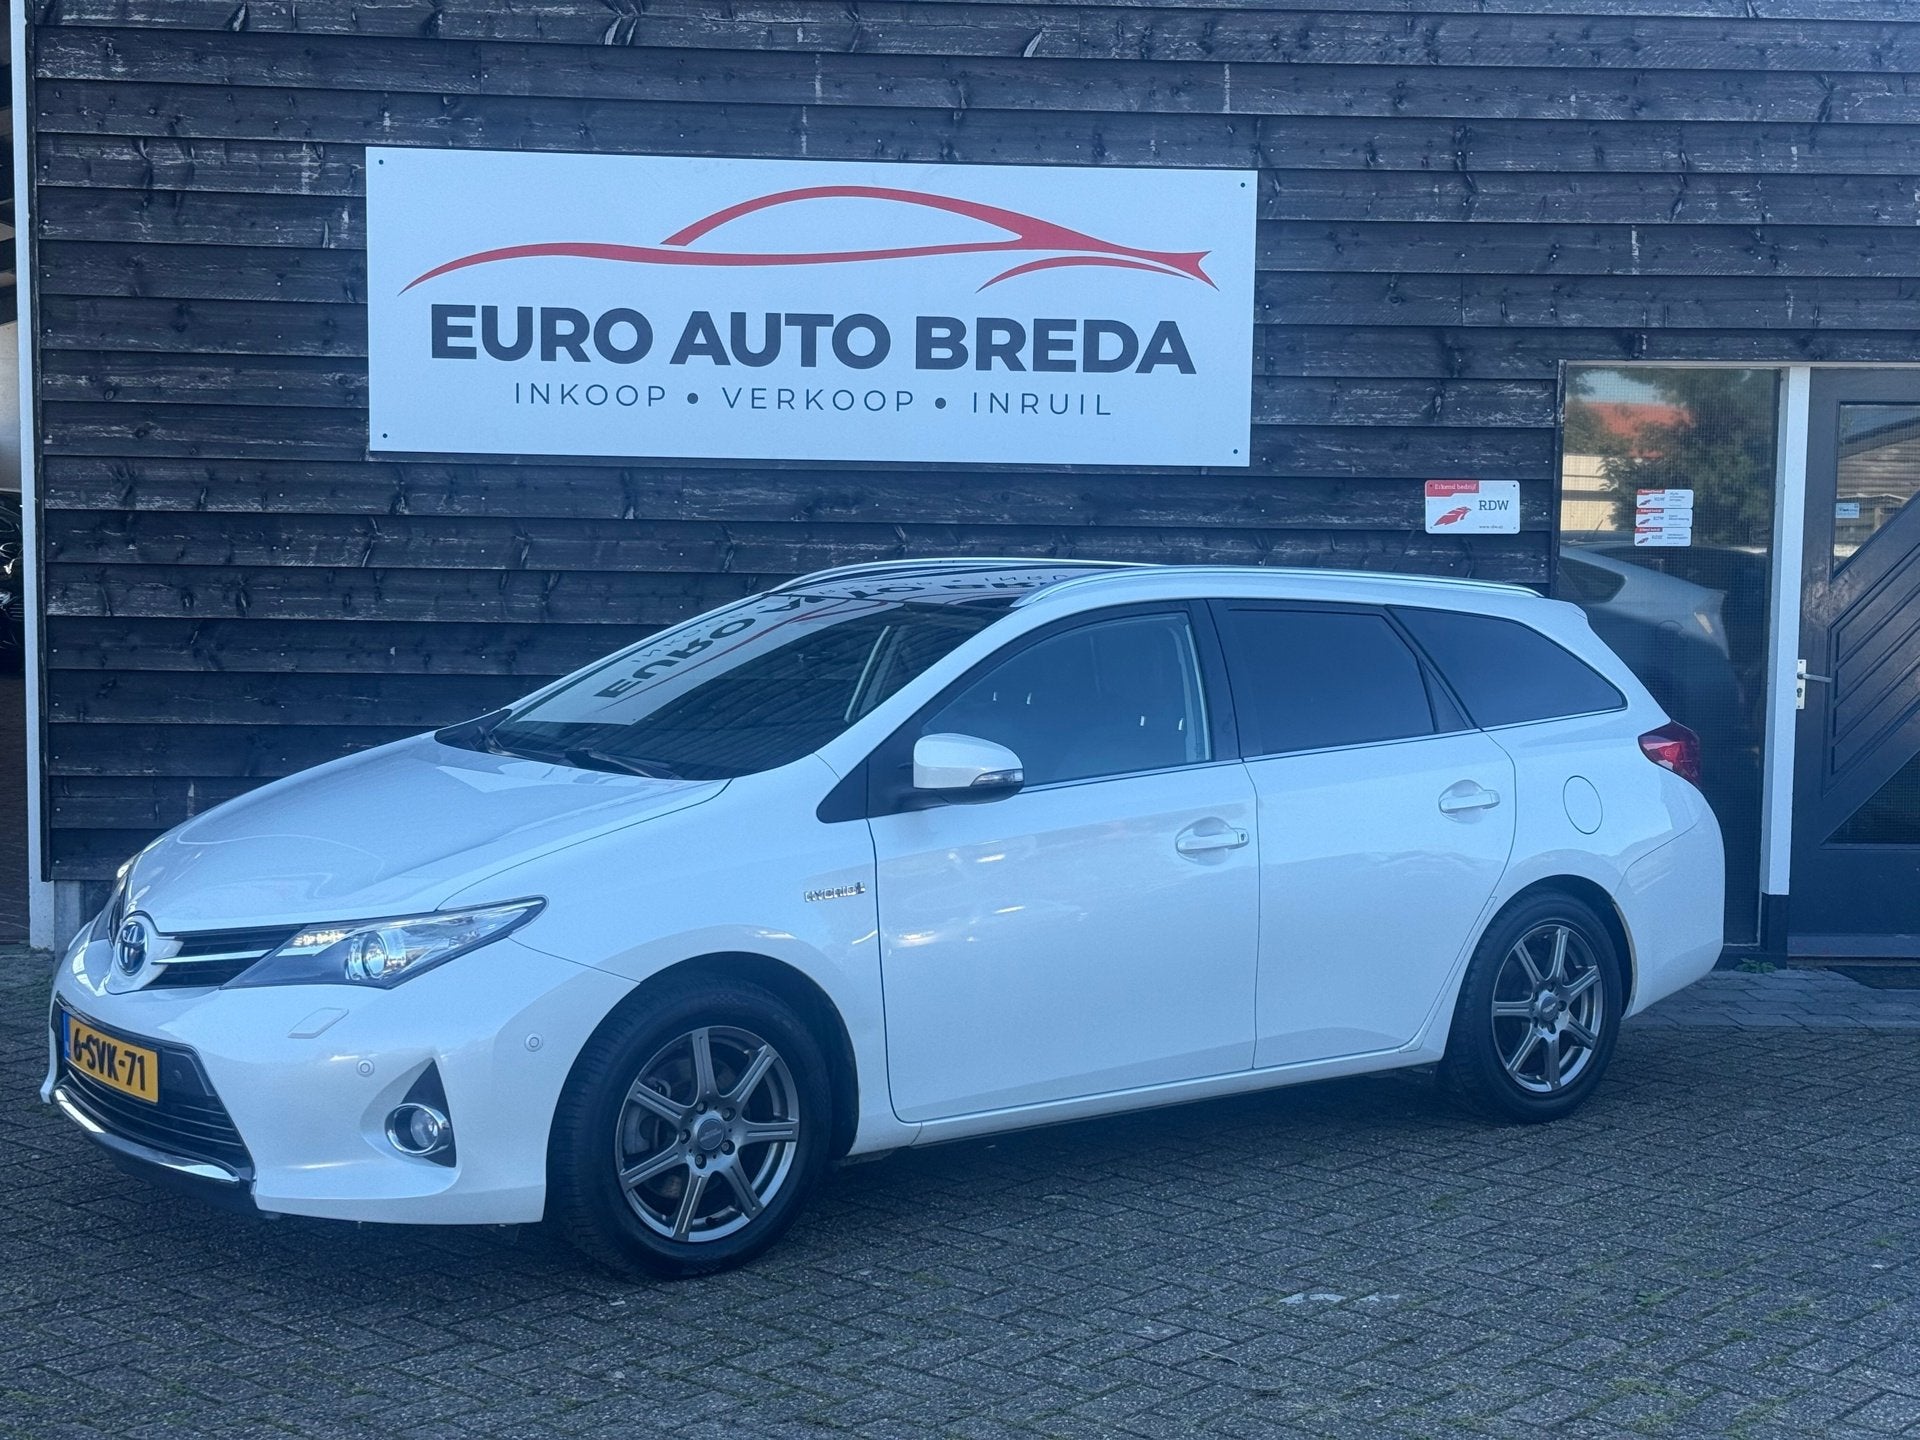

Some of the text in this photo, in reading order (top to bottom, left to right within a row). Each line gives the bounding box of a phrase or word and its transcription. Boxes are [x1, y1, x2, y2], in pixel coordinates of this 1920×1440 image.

[432, 303, 1197, 375] EURO AUTO BREDA
[515, 382, 1111, 416] INKOOP VERKOOP INRUIL
[1478, 499, 1510, 511] RDW
[73, 1027, 146, 1092] 6-SVK-71
